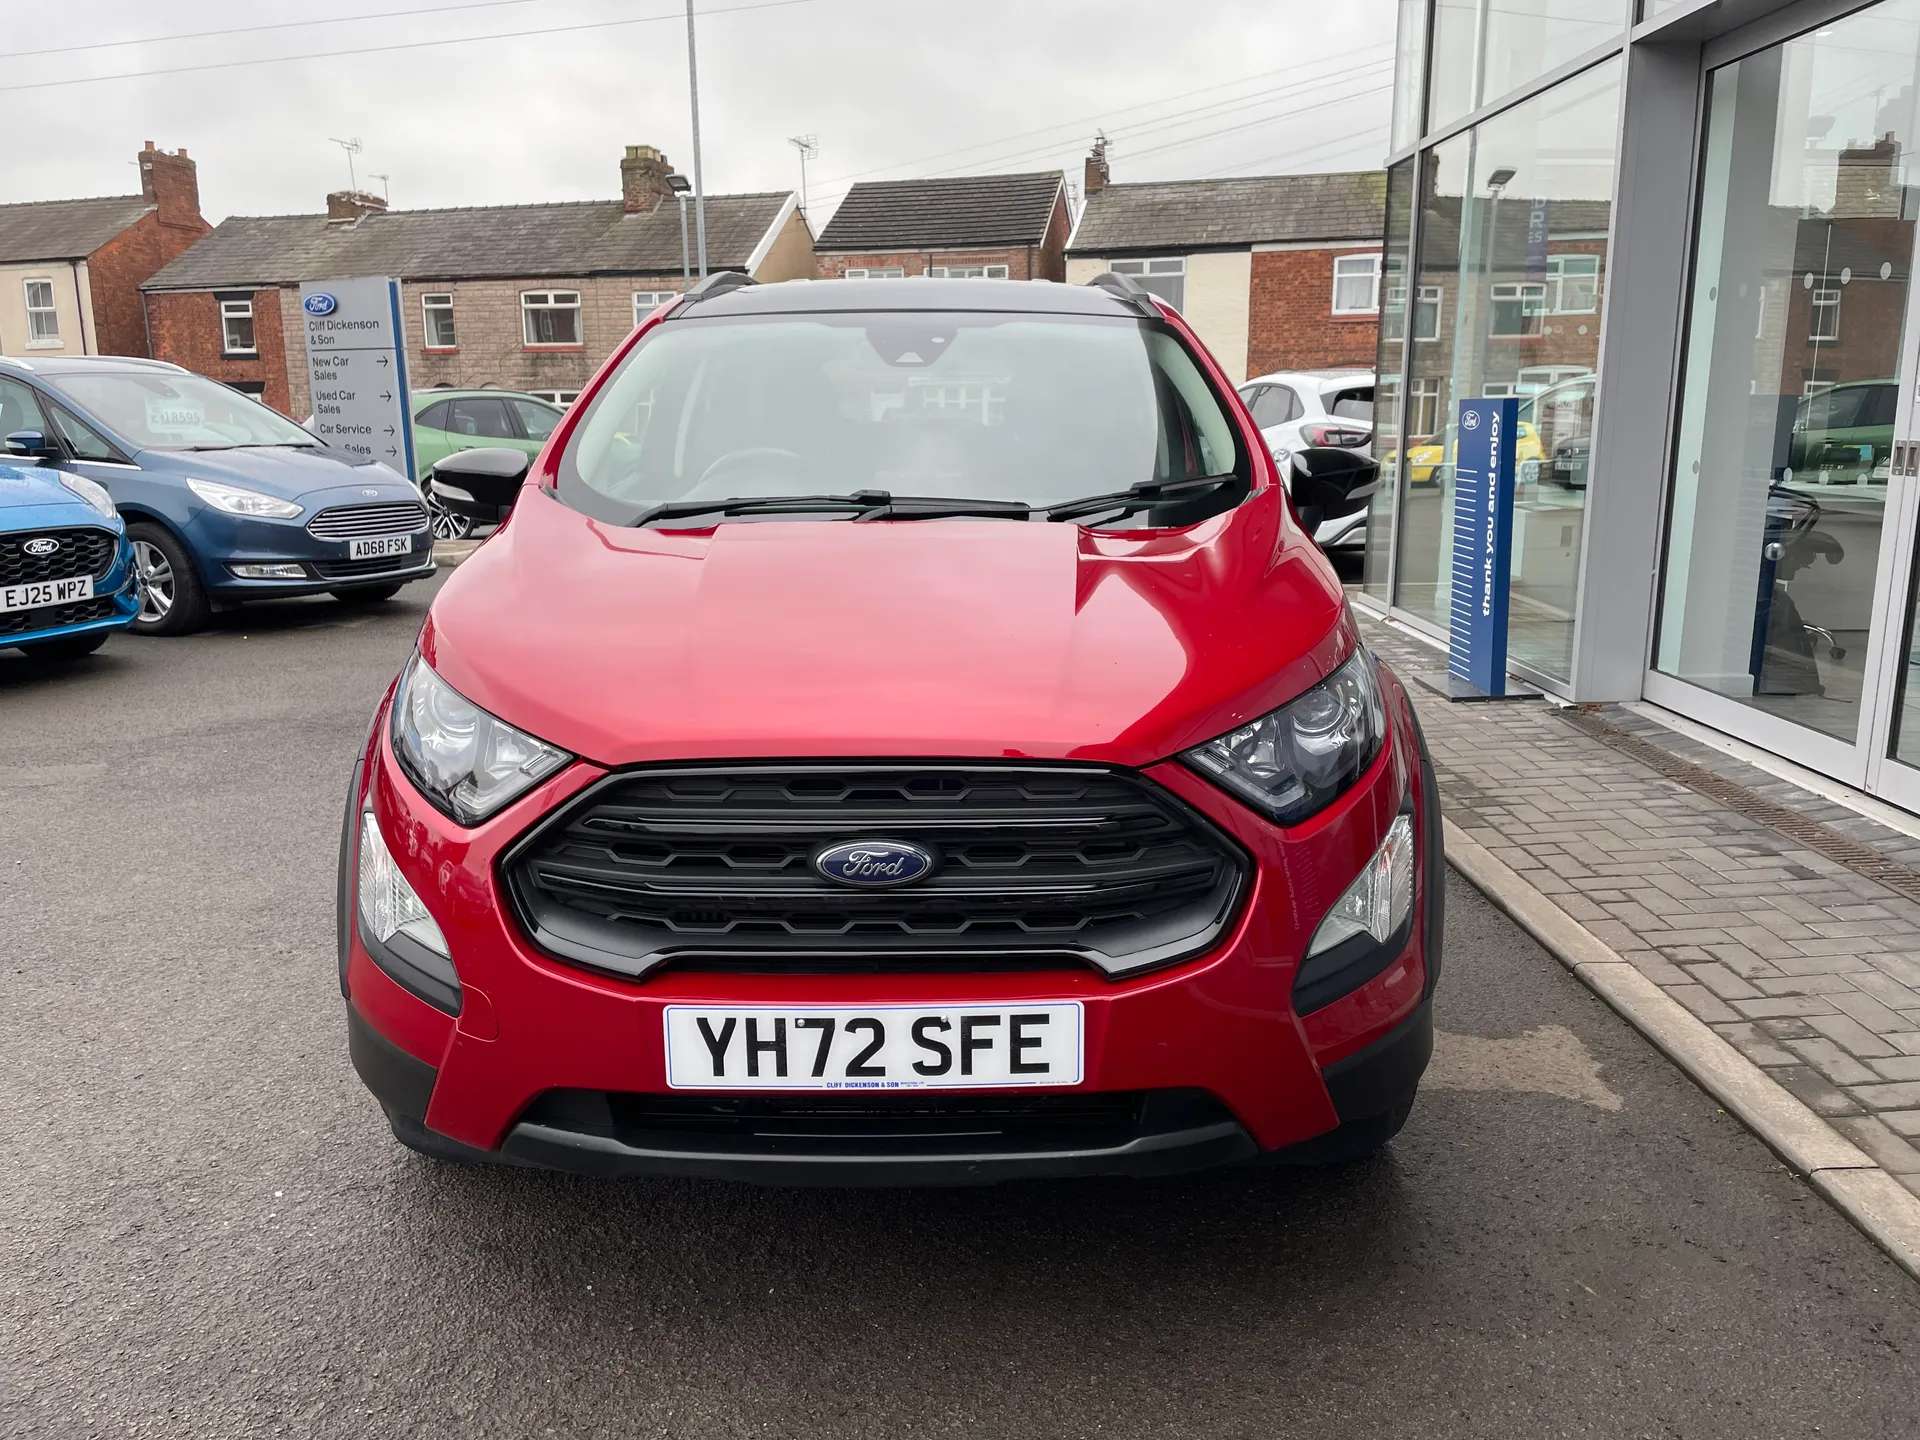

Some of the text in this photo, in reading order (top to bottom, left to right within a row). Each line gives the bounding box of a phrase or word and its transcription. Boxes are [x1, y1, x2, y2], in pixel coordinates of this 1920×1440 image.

[309, 319, 379, 331] Cliff Dickenson
[310, 334, 335, 345] & Son
[313, 356, 349, 367] New Car
[314, 370, 337, 380] Sales
[316, 390, 355, 401] Used Car
[318, 404, 341, 414] Sales
[320, 424, 372, 434] Car Service
[1481, 411, 1501, 616] thank you and enjoy
[356, 537, 407, 557] AD68 FSK
[5, 580, 87, 608] EJ25 WPZ
[842, 850, 905, 877] Ford
[695, 1013, 1050, 1078] YH72 SFE
